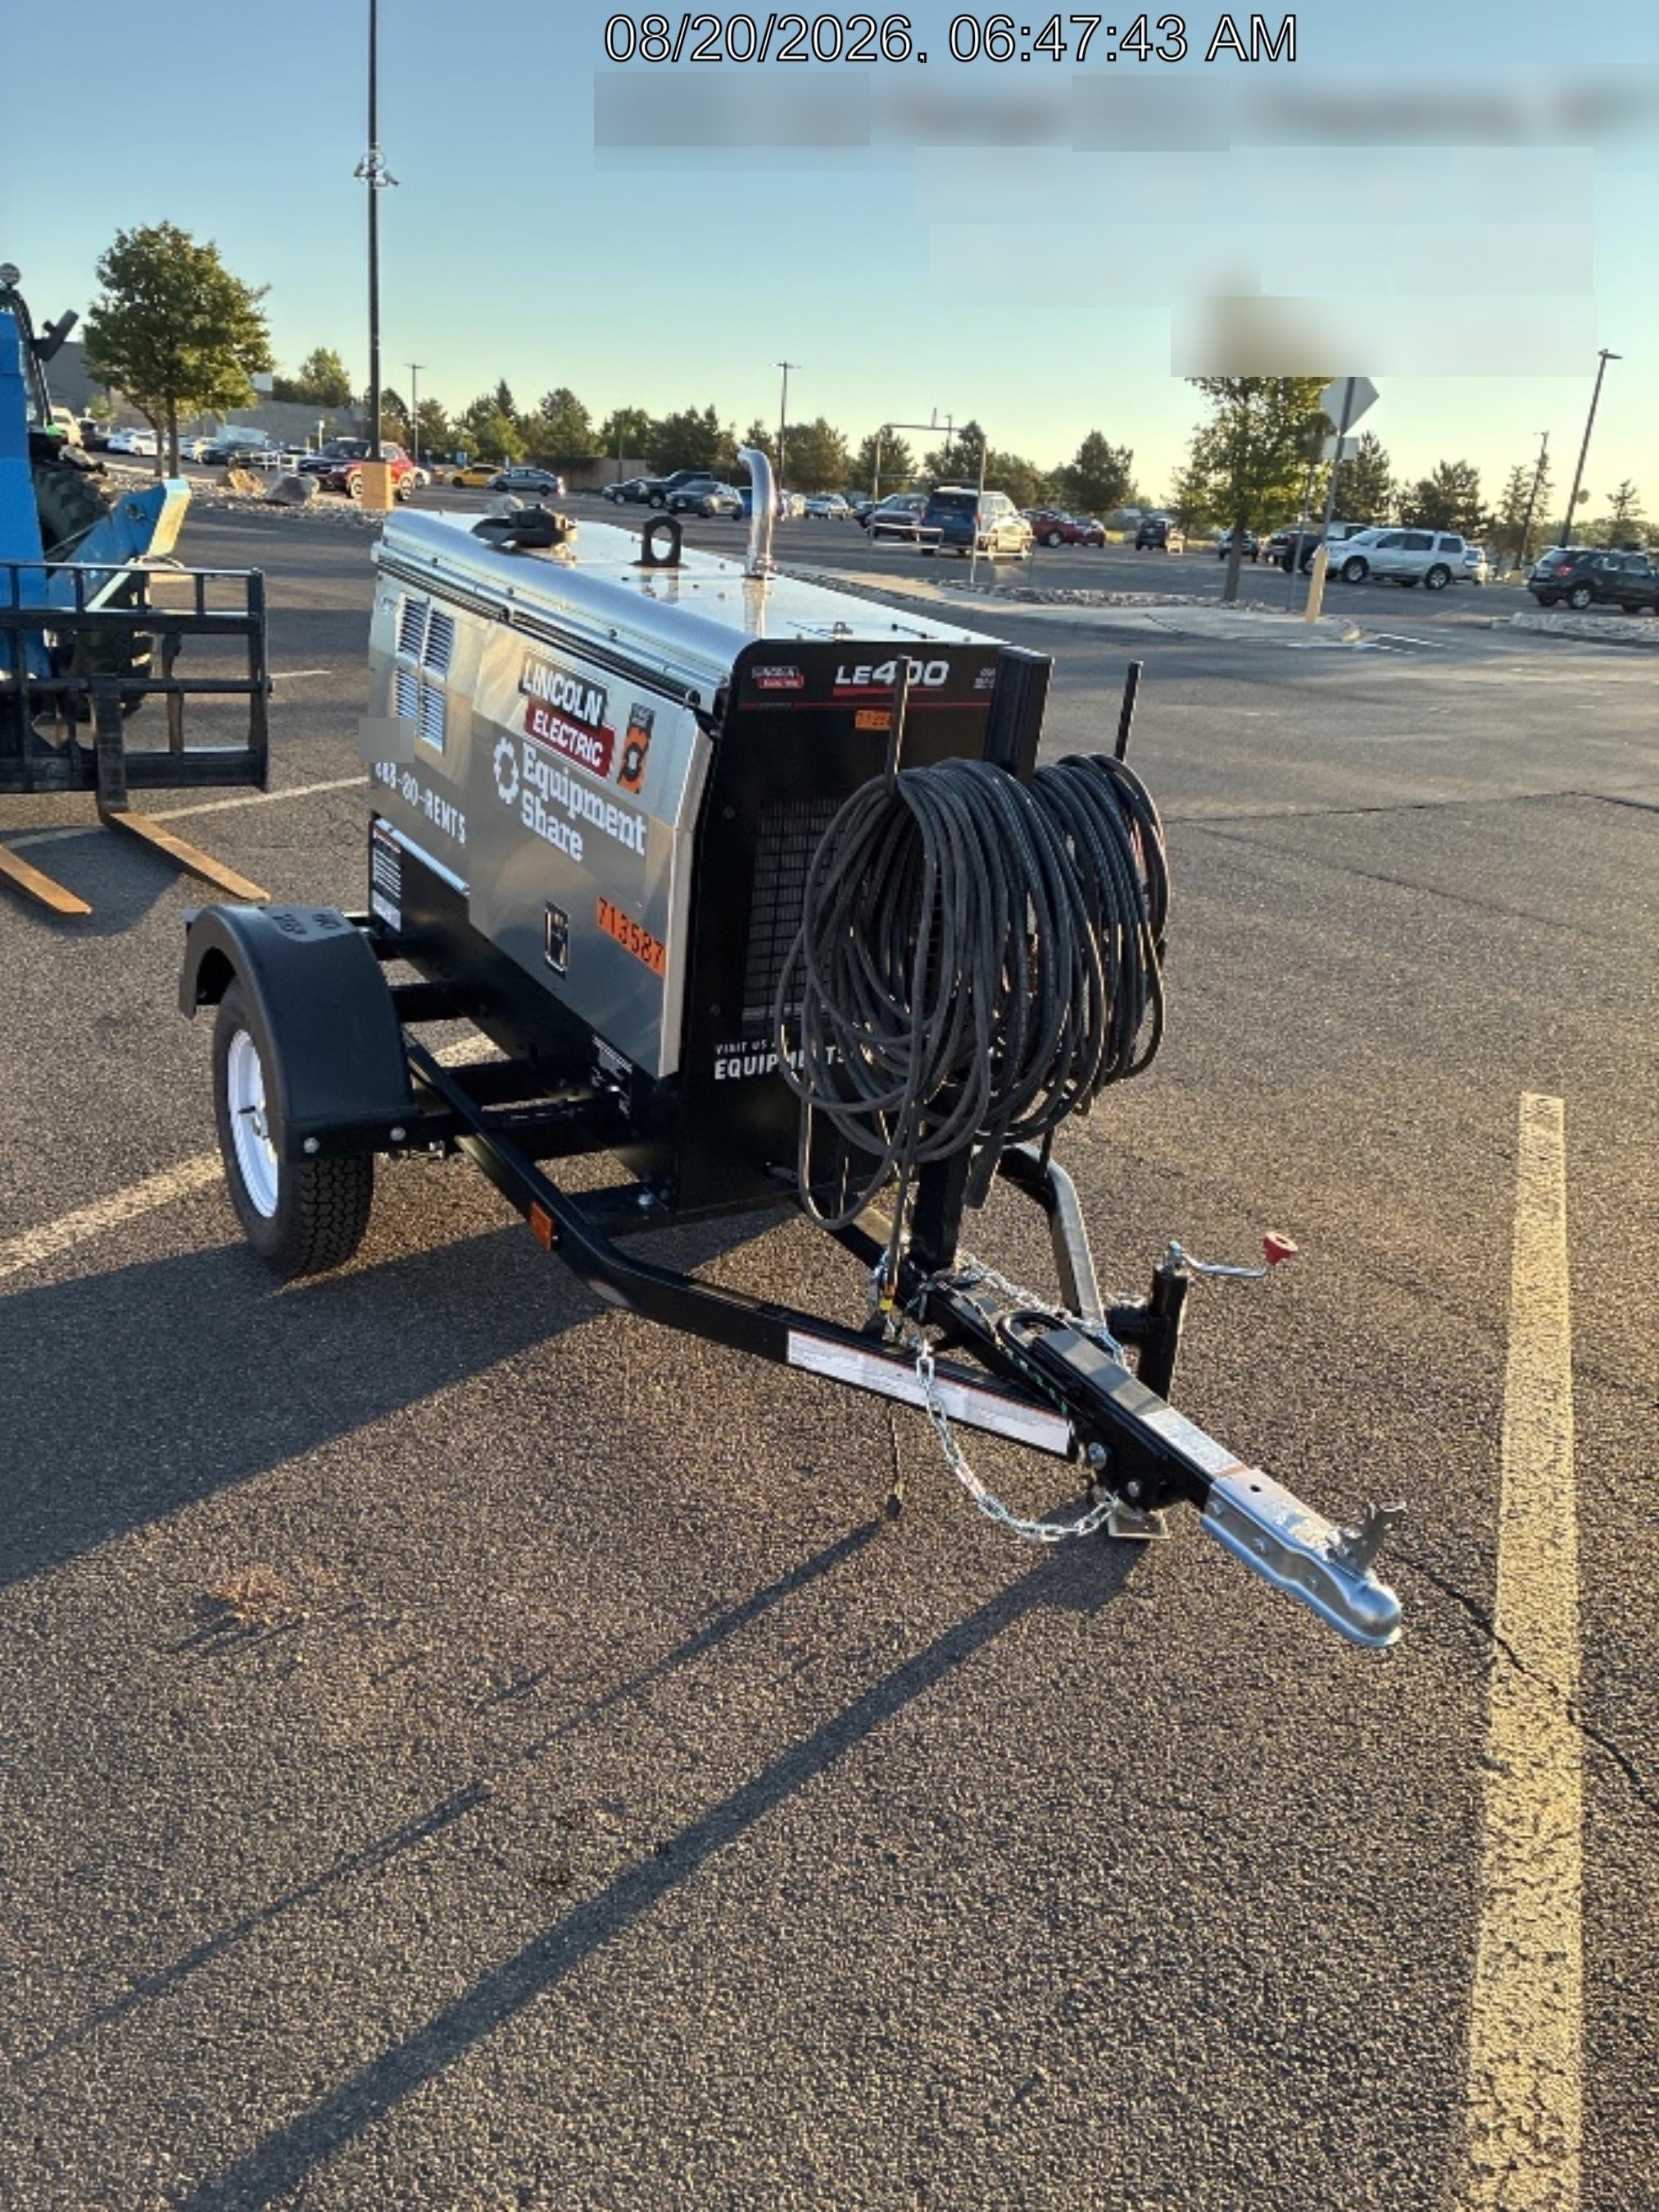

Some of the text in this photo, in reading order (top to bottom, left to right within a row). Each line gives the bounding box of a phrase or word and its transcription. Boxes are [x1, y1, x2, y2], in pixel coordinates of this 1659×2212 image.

[523, 657, 603, 727] LINCOLN
[533, 709, 604, 768] ELECTRIC
[520, 788, 584, 863] Share
[522, 741, 647, 857] Equipment
[599, 895, 664, 964] 713587
